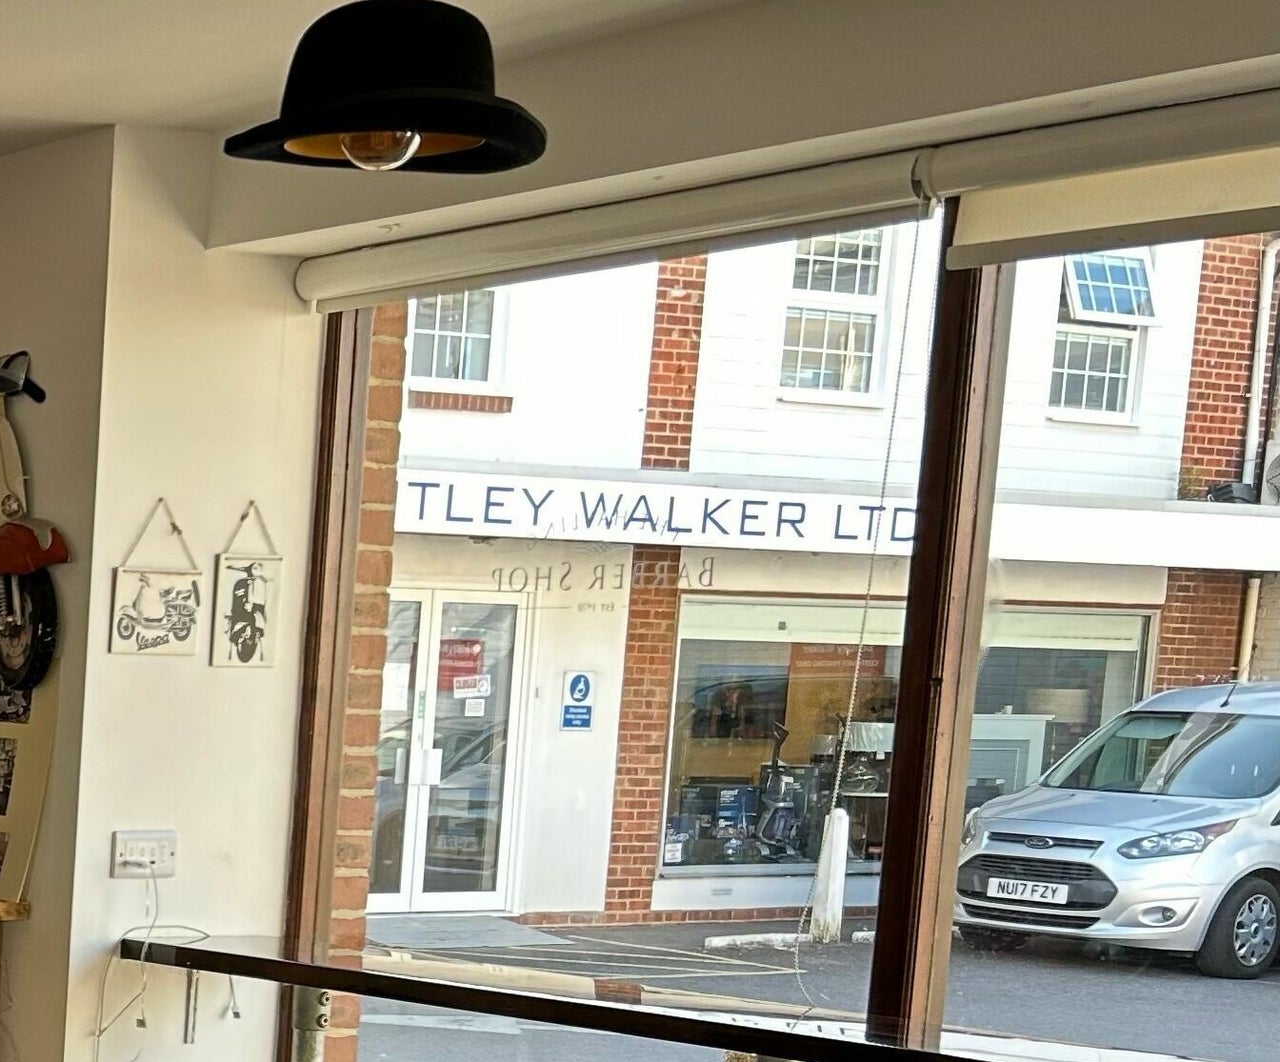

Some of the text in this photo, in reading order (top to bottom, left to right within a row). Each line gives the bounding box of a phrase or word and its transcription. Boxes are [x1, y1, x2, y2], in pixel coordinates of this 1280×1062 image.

[408, 482, 916, 542] TLEY WALKER LTD
[136, 632, 170, 651] Vespa
[997, 880, 1059, 899] NU17 FZY
